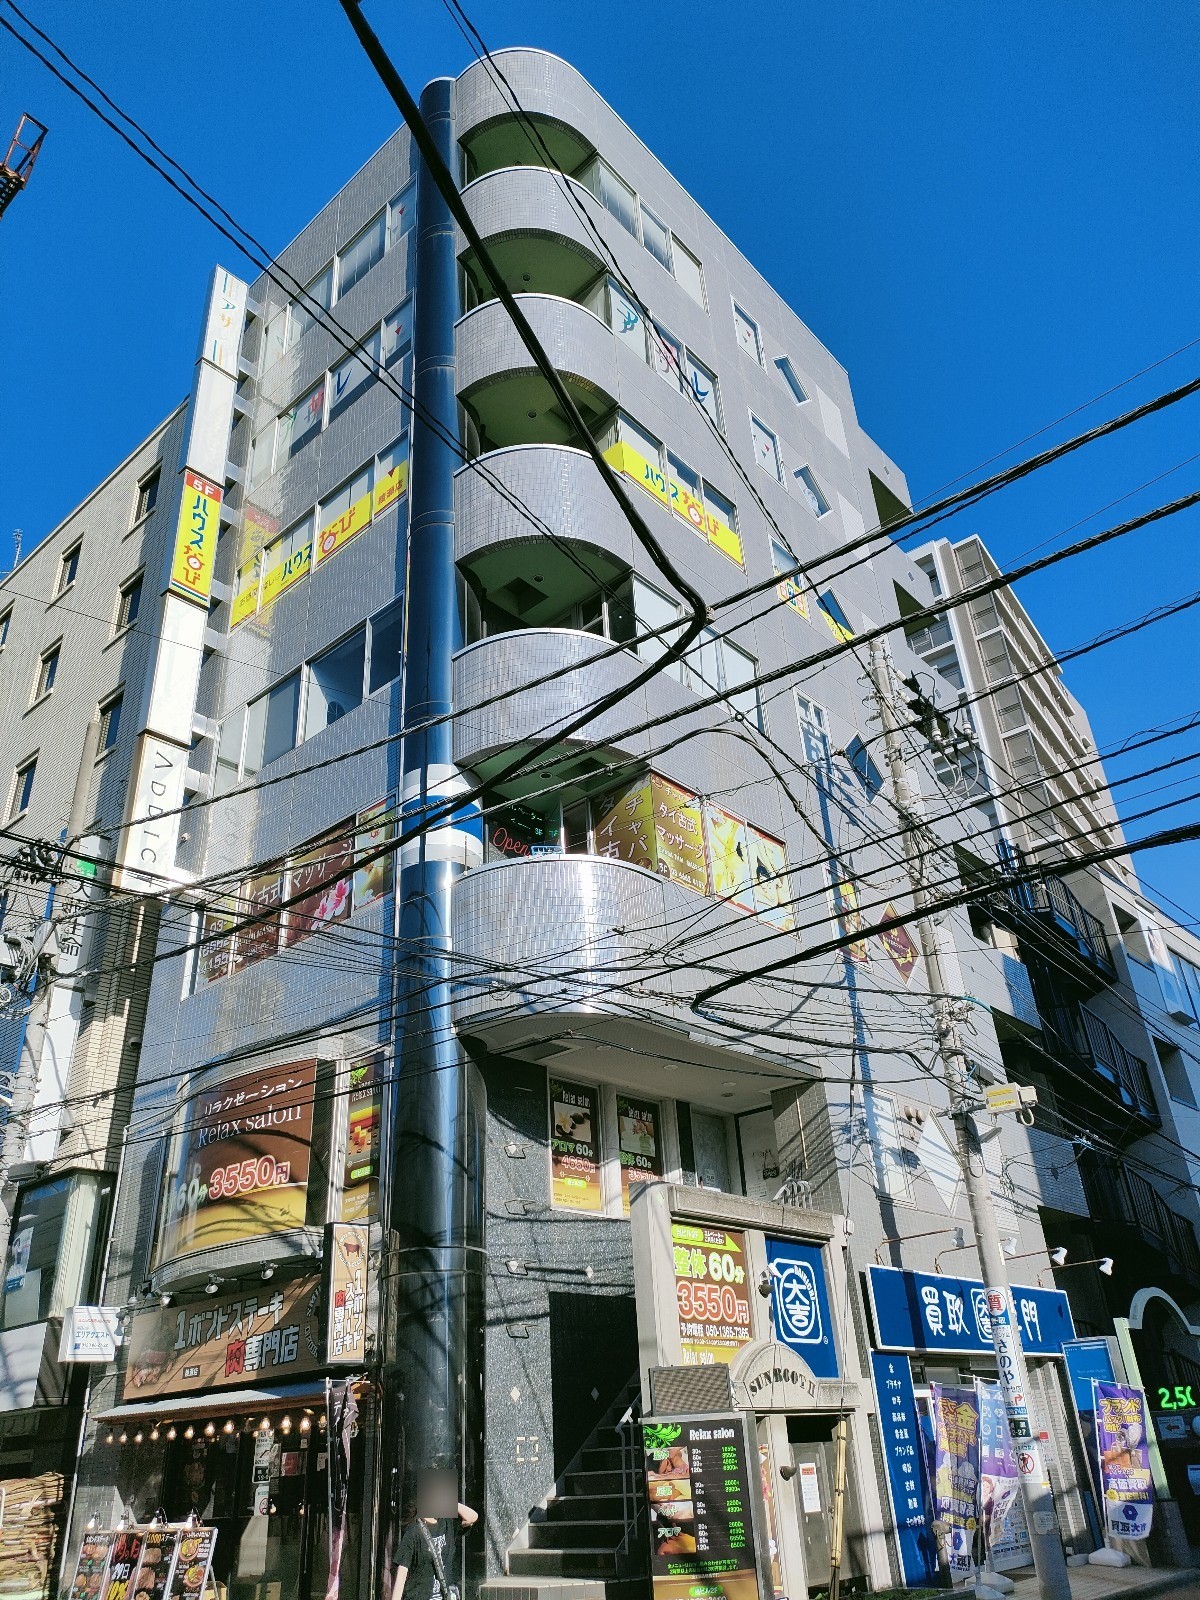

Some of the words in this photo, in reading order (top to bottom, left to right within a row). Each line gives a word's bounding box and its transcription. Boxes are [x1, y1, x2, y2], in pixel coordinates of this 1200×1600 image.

[193, 479, 215, 497] 5F
[645, 463, 720, 537] ハウスなび
[183, 495, 207, 586] ハウスなび
[281, 506, 356, 581] ハウスなび
[493, 827, 530, 856] Open
[659, 863, 668, 874] 3F
[204, 1079, 303, 1118] リラクゼーション
[198, 1117, 242, 1148] Relax
[245, 1104, 302, 1132] salon
[551, 1138, 575, 1153] アロマ
[208, 1155, 291, 1200] 3550円
[561, 1155, 596, 1174] 4650円
[673, 1245, 708, 1280] 整体
[708, 1252, 746, 1285] 60分
[174, 1290, 285, 1351] 1ポンドステーキ
[332, 1289, 346, 1357] 肉専門店
[343, 1281, 355, 1352] ステーキ
[353, 1268, 366, 1351] 1ポンド
[676, 1280, 750, 1325] 3550円
[783, 1278, 812, 1329] 大吉
[920, 1285, 971, 1337] 買取
[987, 1294, 1003, 1312] 質
[225, 1323, 300, 1378] 肉専門店
[1100, 1398, 1141, 1414] ブランド
[689, 1429, 712, 1441] Relax
[713, 1427, 735, 1439] salon
